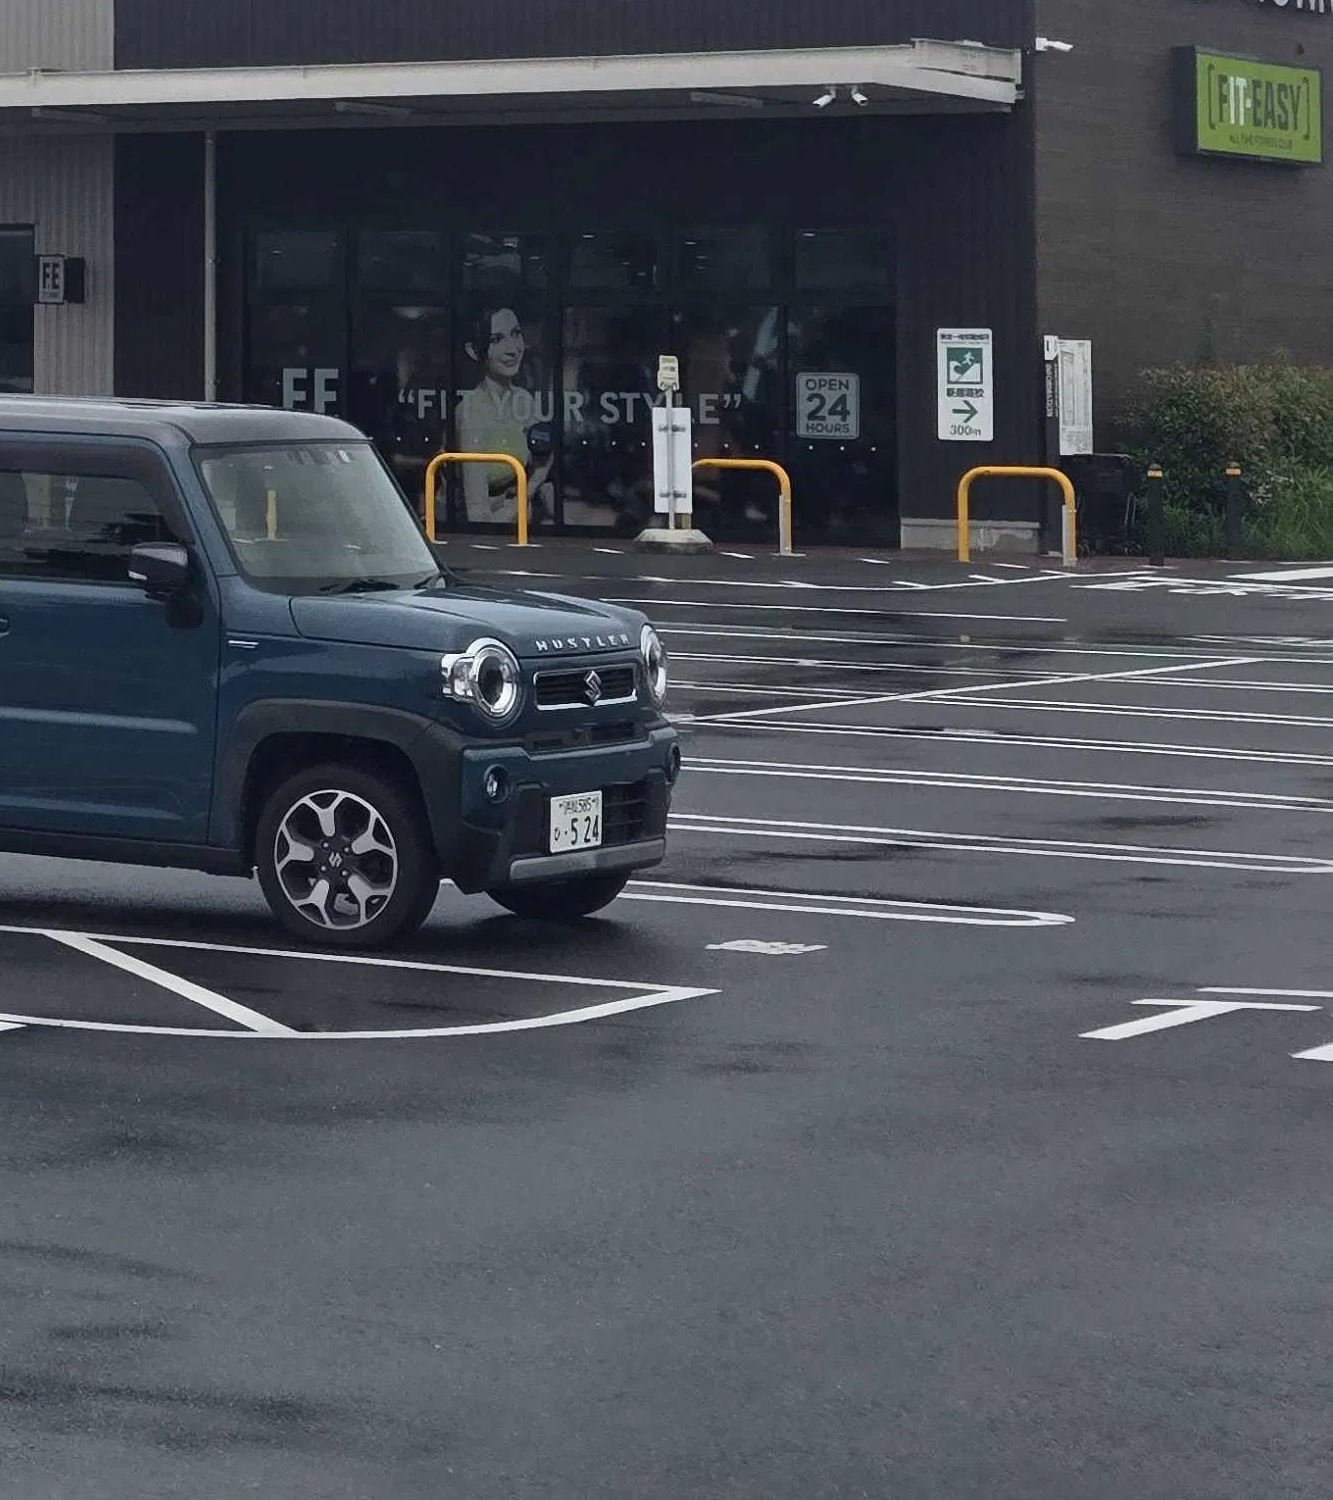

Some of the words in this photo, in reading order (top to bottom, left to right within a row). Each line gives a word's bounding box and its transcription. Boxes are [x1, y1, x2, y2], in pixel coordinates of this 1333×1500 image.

[805, 378, 849, 391] OPEN
[489, 390, 583, 422] YOUR
[806, 393, 851, 422] 24
[805, 422, 850, 433] HOURS
[535, 634, 630, 652] HUSTLER
